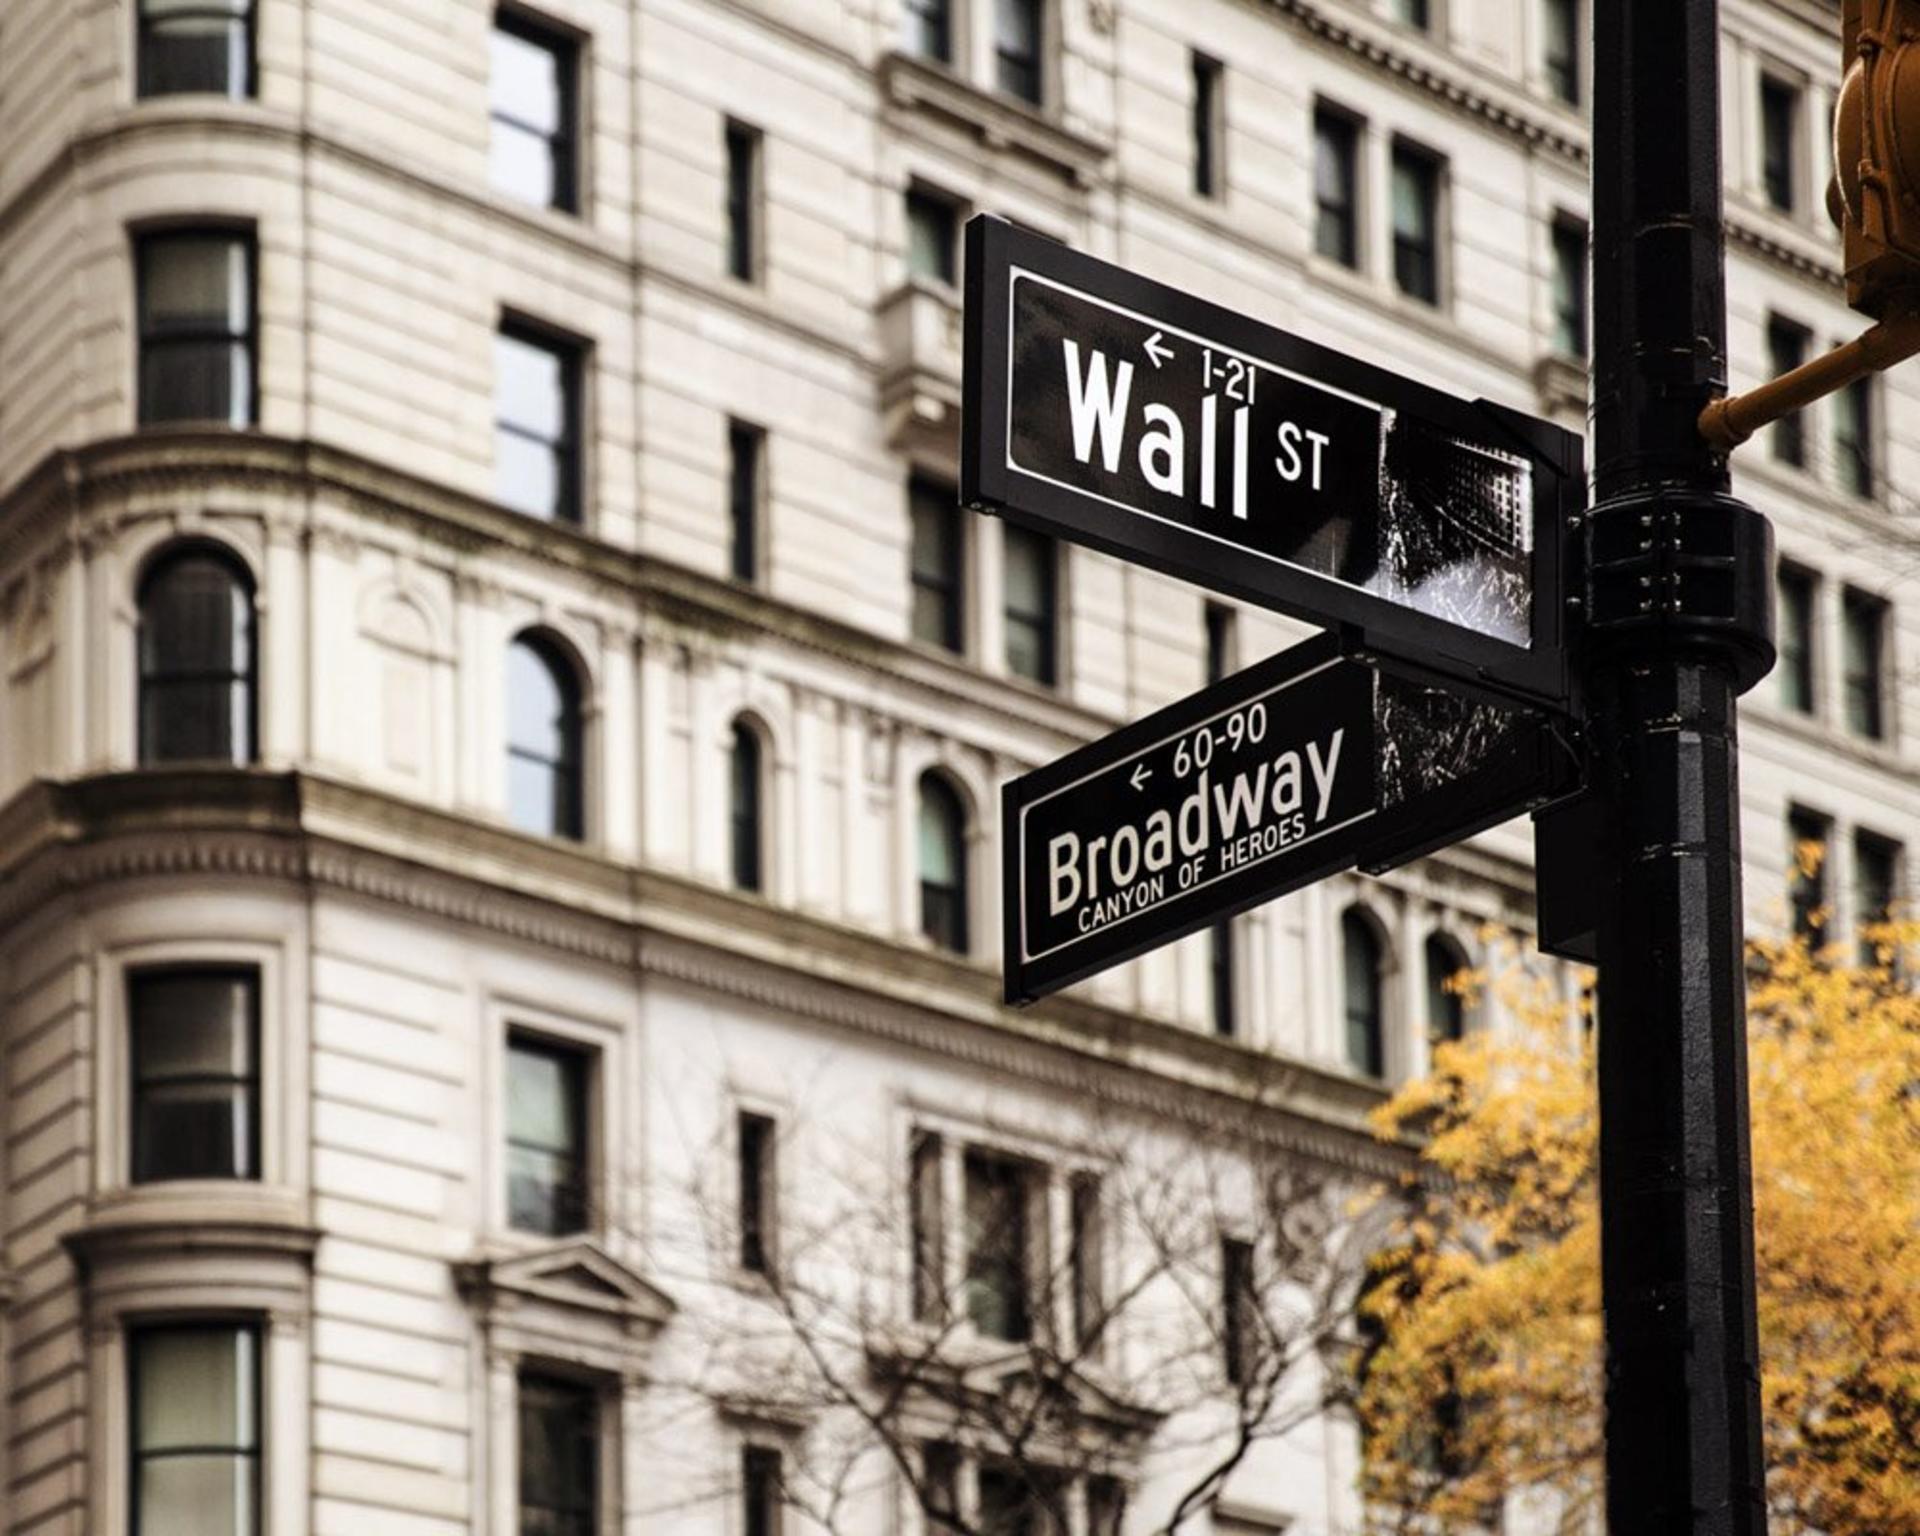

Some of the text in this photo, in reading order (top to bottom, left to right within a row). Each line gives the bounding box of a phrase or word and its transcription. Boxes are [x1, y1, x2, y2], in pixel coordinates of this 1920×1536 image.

[1062, 337, 1330, 520] Wall ST
[1202, 348, 1256, 405] 1-21
[1173, 702, 1267, 779] 60-90
[1048, 728, 1344, 918] Broadway
[1078, 813, 1305, 932] CANYON OF HEROES
